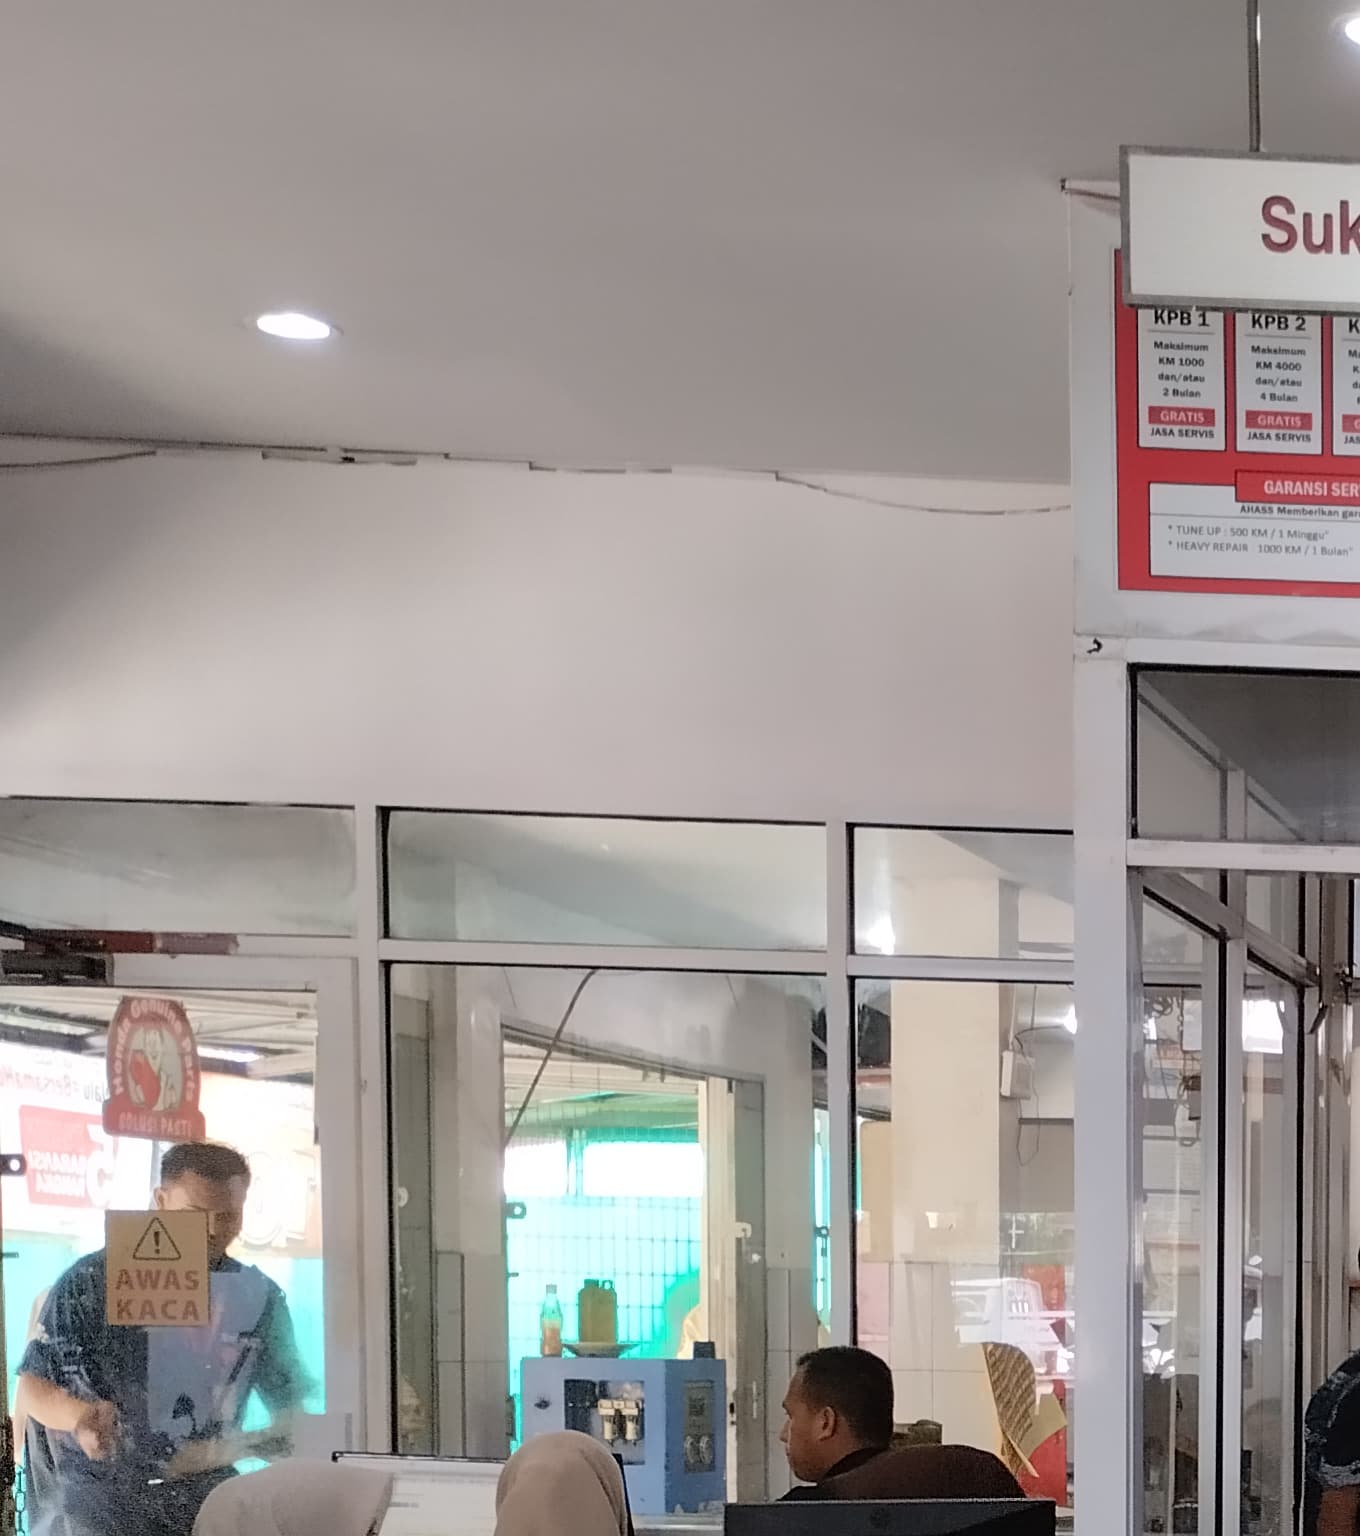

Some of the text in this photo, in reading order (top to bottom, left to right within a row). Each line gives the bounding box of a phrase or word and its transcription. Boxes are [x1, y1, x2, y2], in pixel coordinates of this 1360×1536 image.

[1154, 309, 1210, 327] KPB 1
[1251, 314, 1306, 331] KPB 2
[1154, 341, 1209, 352] Maksimum
[1251, 345, 1306, 356] Maksimum
[1159, 357, 1204, 367] KM 1000
[1256, 361, 1302, 371] KM 4000
[1163, 388, 1201, 398] 2 Bulan
[1269, 392, 1298, 402] Bulan
[1160, 411, 1205, 423] GRATIS
[1258, 414, 1302, 426] GRATIS
[1151, 428, 1215, 439] JASA SERVIS
[1248, 432, 1311, 443] JASA SERVIS
[1264, 480, 1328, 498] GARANSI
[1176, 525, 1268, 538] TUNE UP 500 KM
[1176, 541, 1302, 556] HEAVY REPAIR 1000 KM
[115, 1268, 200, 1291] AWAS
[115, 1298, 200, 1322] KACA
